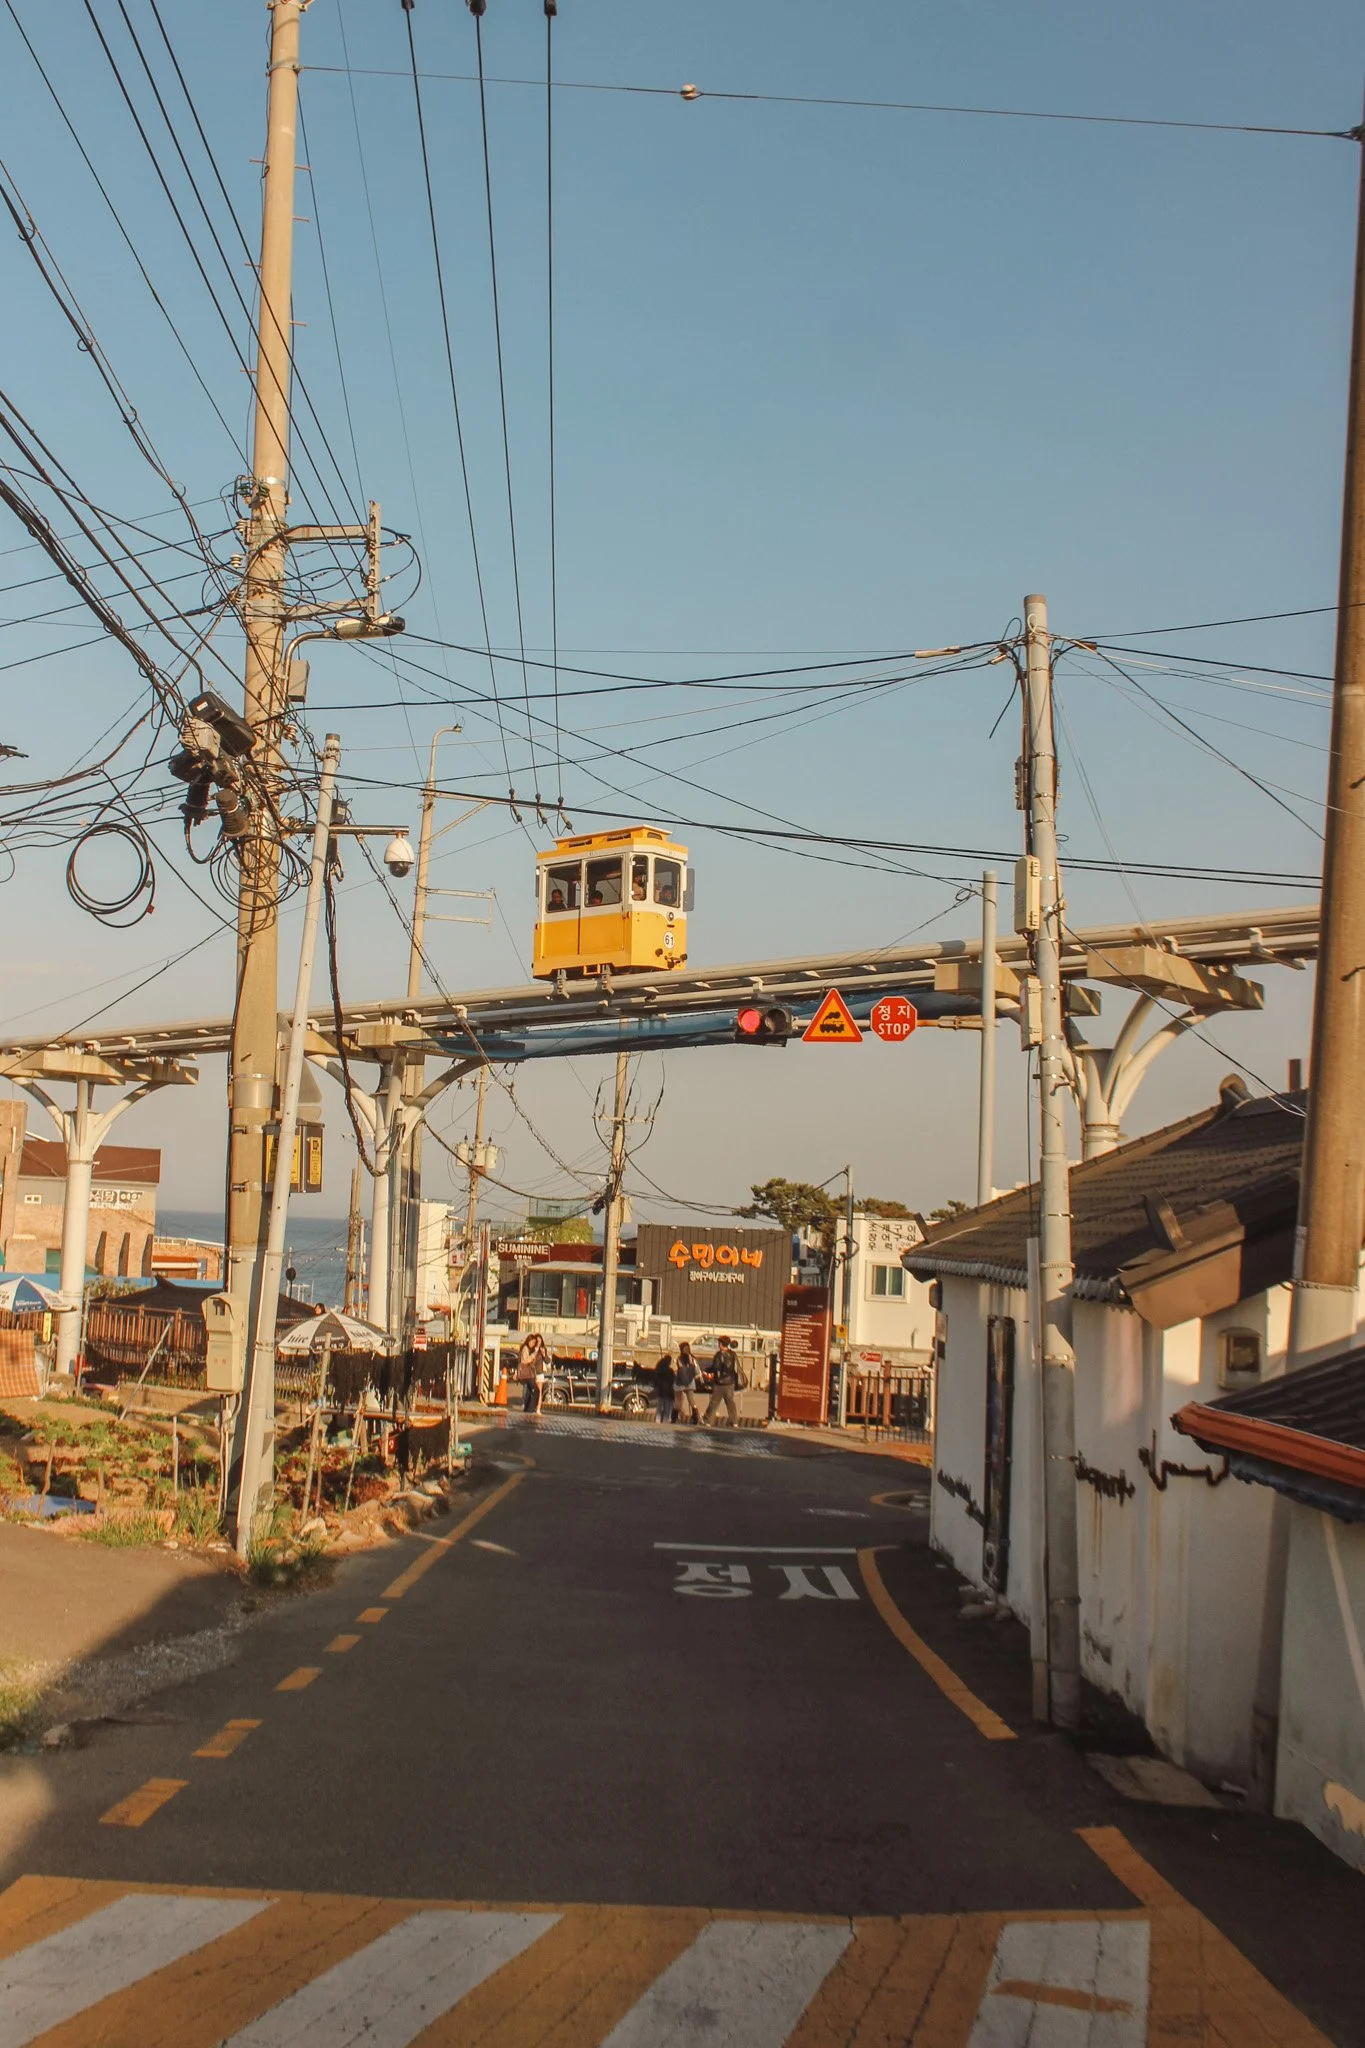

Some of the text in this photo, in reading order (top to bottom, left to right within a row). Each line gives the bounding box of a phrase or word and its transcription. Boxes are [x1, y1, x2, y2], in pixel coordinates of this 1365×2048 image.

[665, 935, 674, 946] 61
[878, 1004, 911, 1020] 정지
[878, 1023, 910, 1035] STOP
[497, 1243, 549, 1255] SUMININE
[668, 1239, 763, 1269] 수민이네
[673, 1560, 860, 1600] 정지
